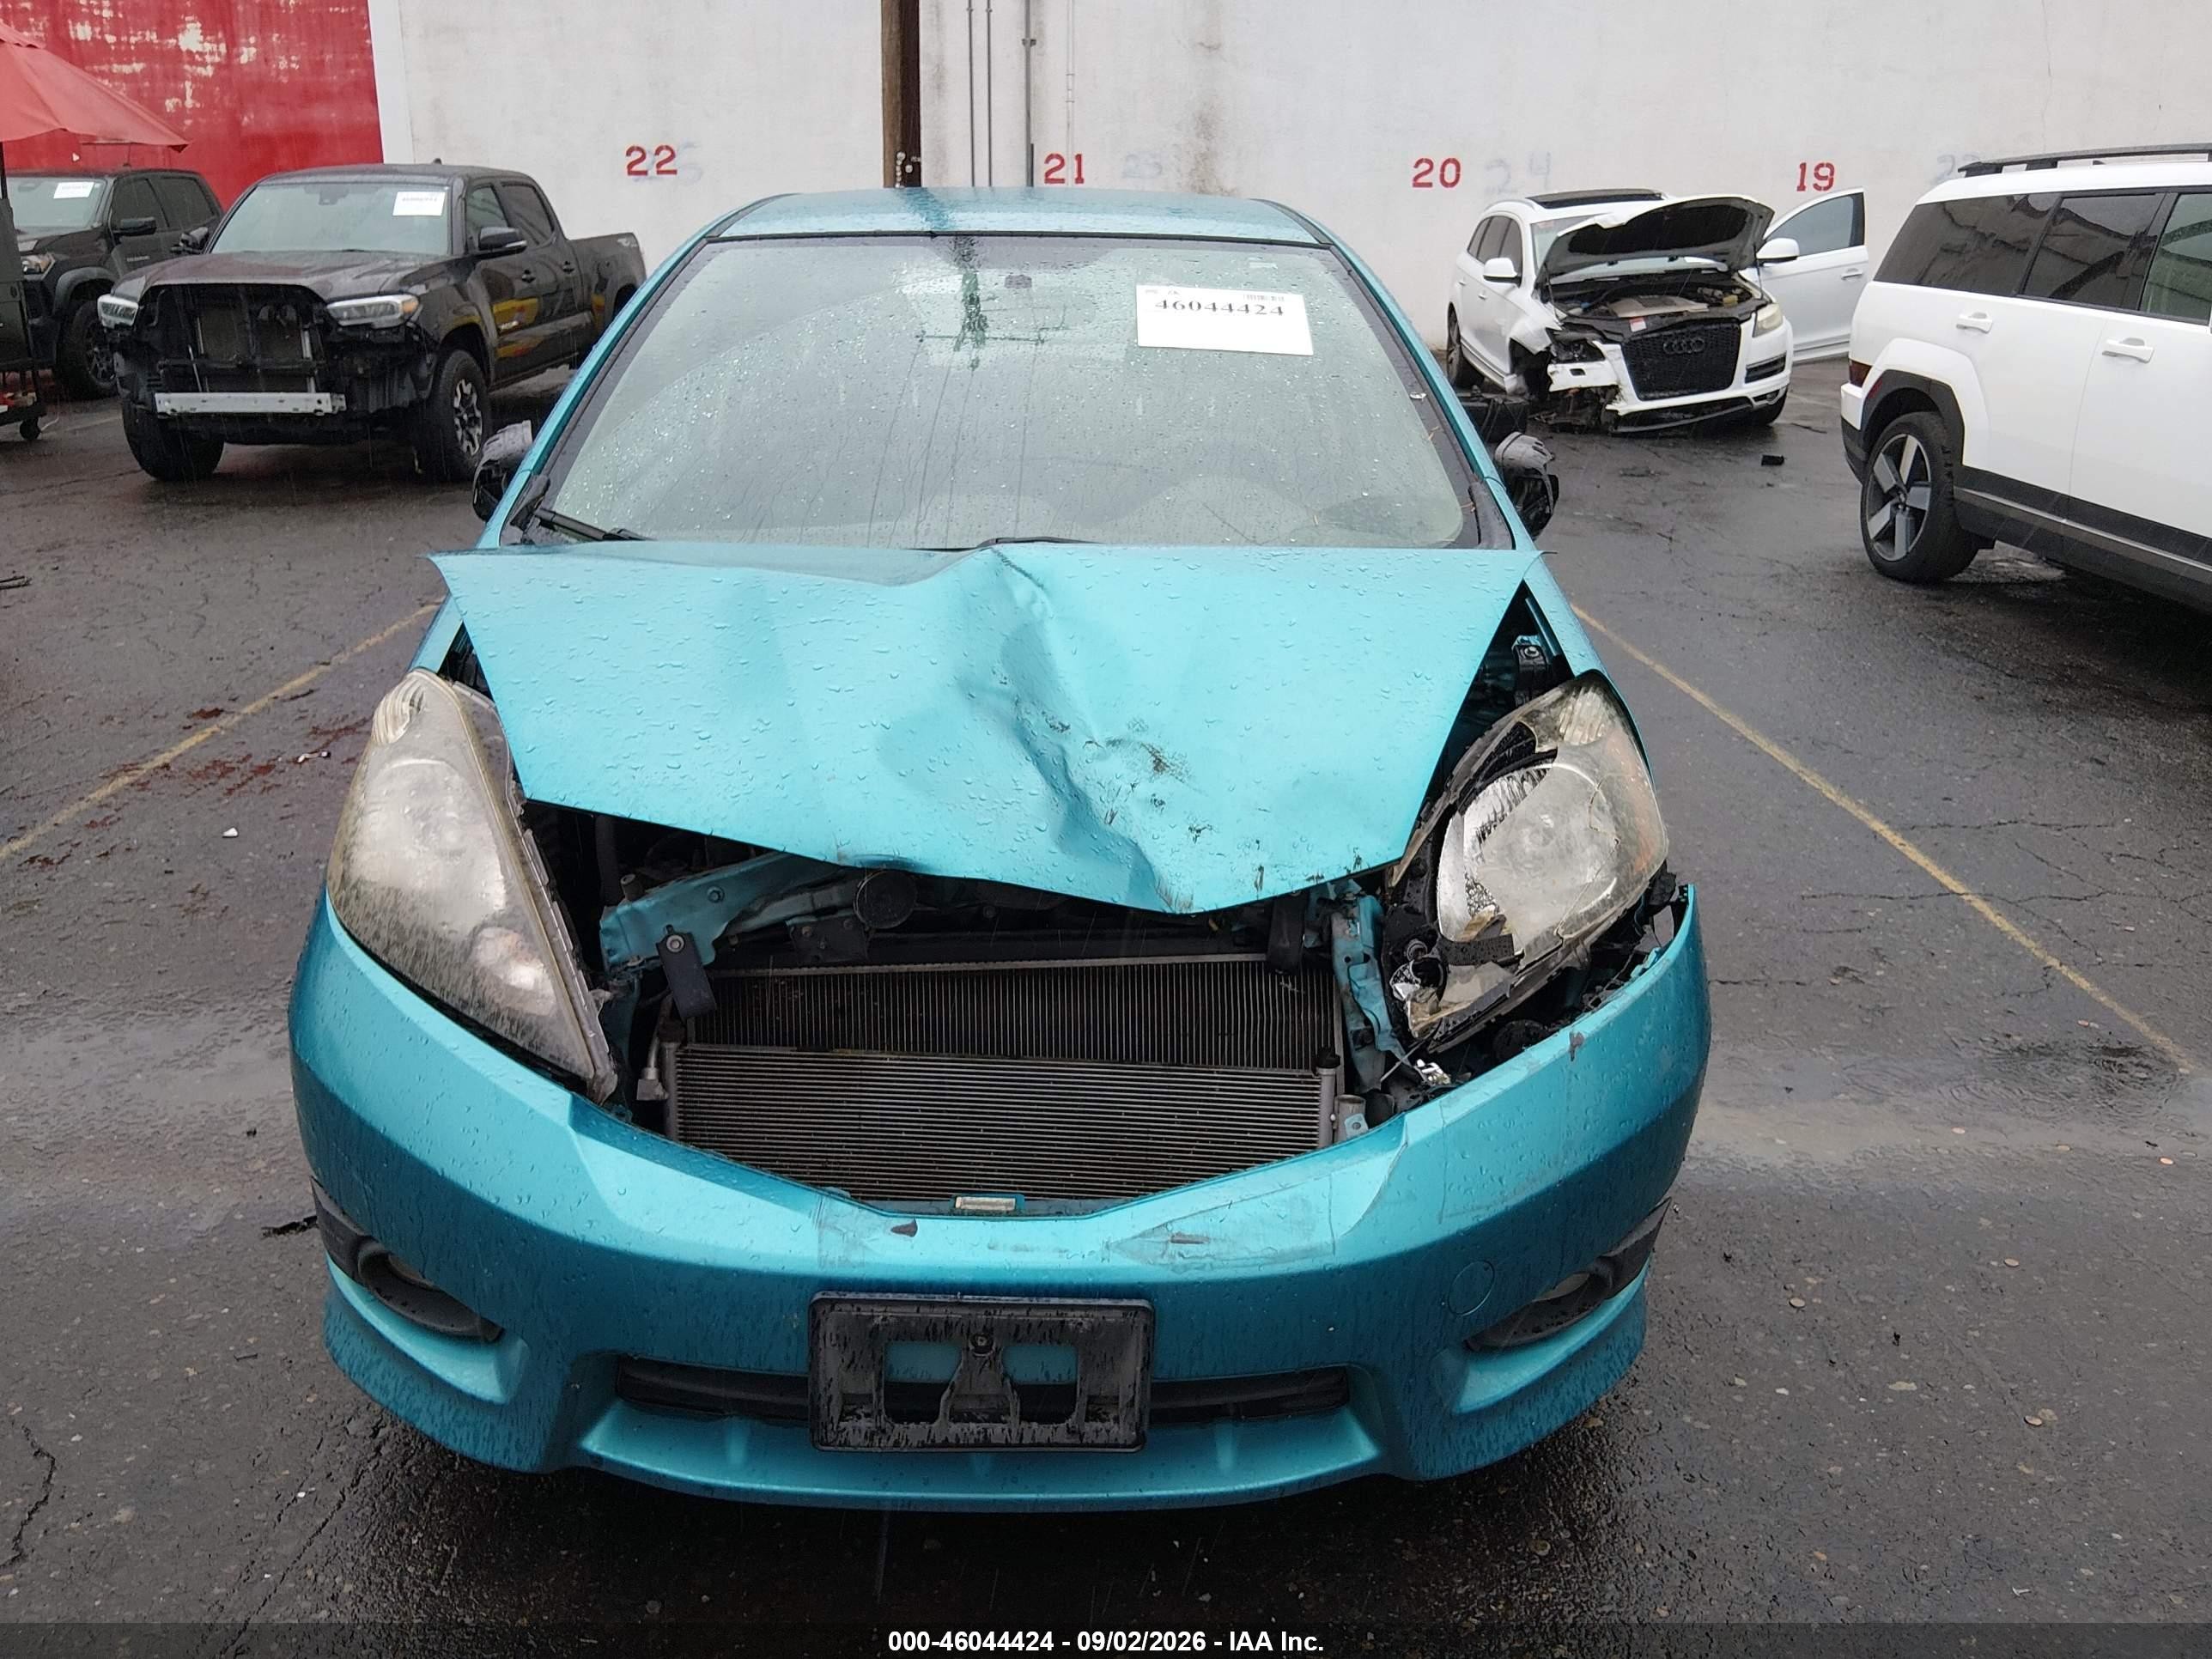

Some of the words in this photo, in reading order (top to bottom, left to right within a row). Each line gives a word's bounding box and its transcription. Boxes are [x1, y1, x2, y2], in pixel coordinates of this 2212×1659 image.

[626, 145, 678, 176] 22
[1044, 153, 1085, 184] 21
[1413, 158, 1461, 188] 20
[1796, 162, 1836, 191] 19
[1155, 299, 1284, 316] 46044424
